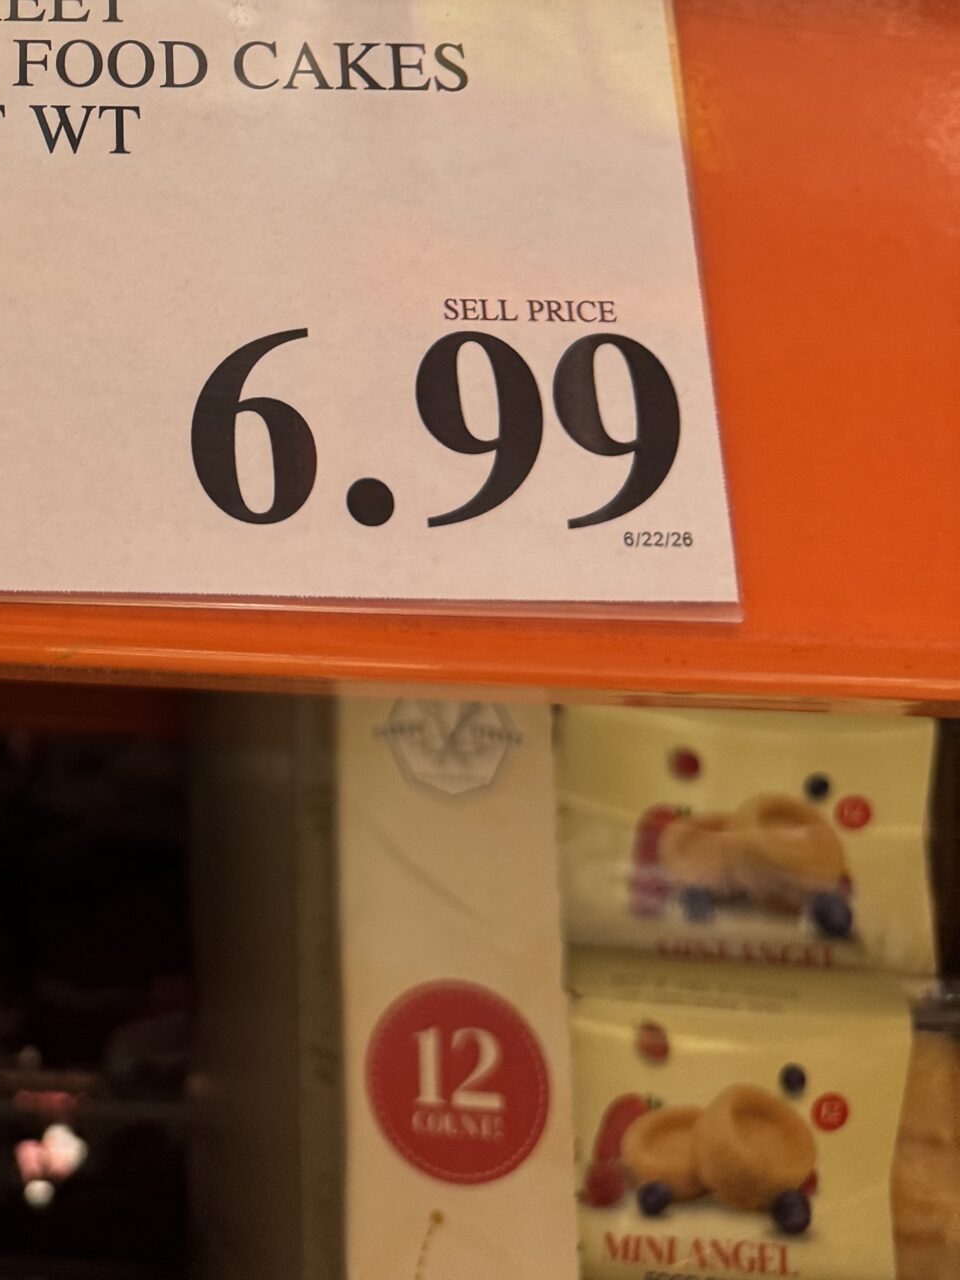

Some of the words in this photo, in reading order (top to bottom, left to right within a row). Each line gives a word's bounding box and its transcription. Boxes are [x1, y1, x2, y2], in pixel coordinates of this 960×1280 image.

[12, 39, 209, 89] FOOD
[233, 41, 470, 93] CAKES
[28, 104, 141, 155] WT
[443, 297, 519, 322] SELL
[526, 299, 618, 324] PRICE
[190, 327, 681, 530] 6.99
[623, 530, 694, 549] 6/22/26
[411, 1025, 503, 1111] 12
[604, 1230, 679, 1265] MINI
